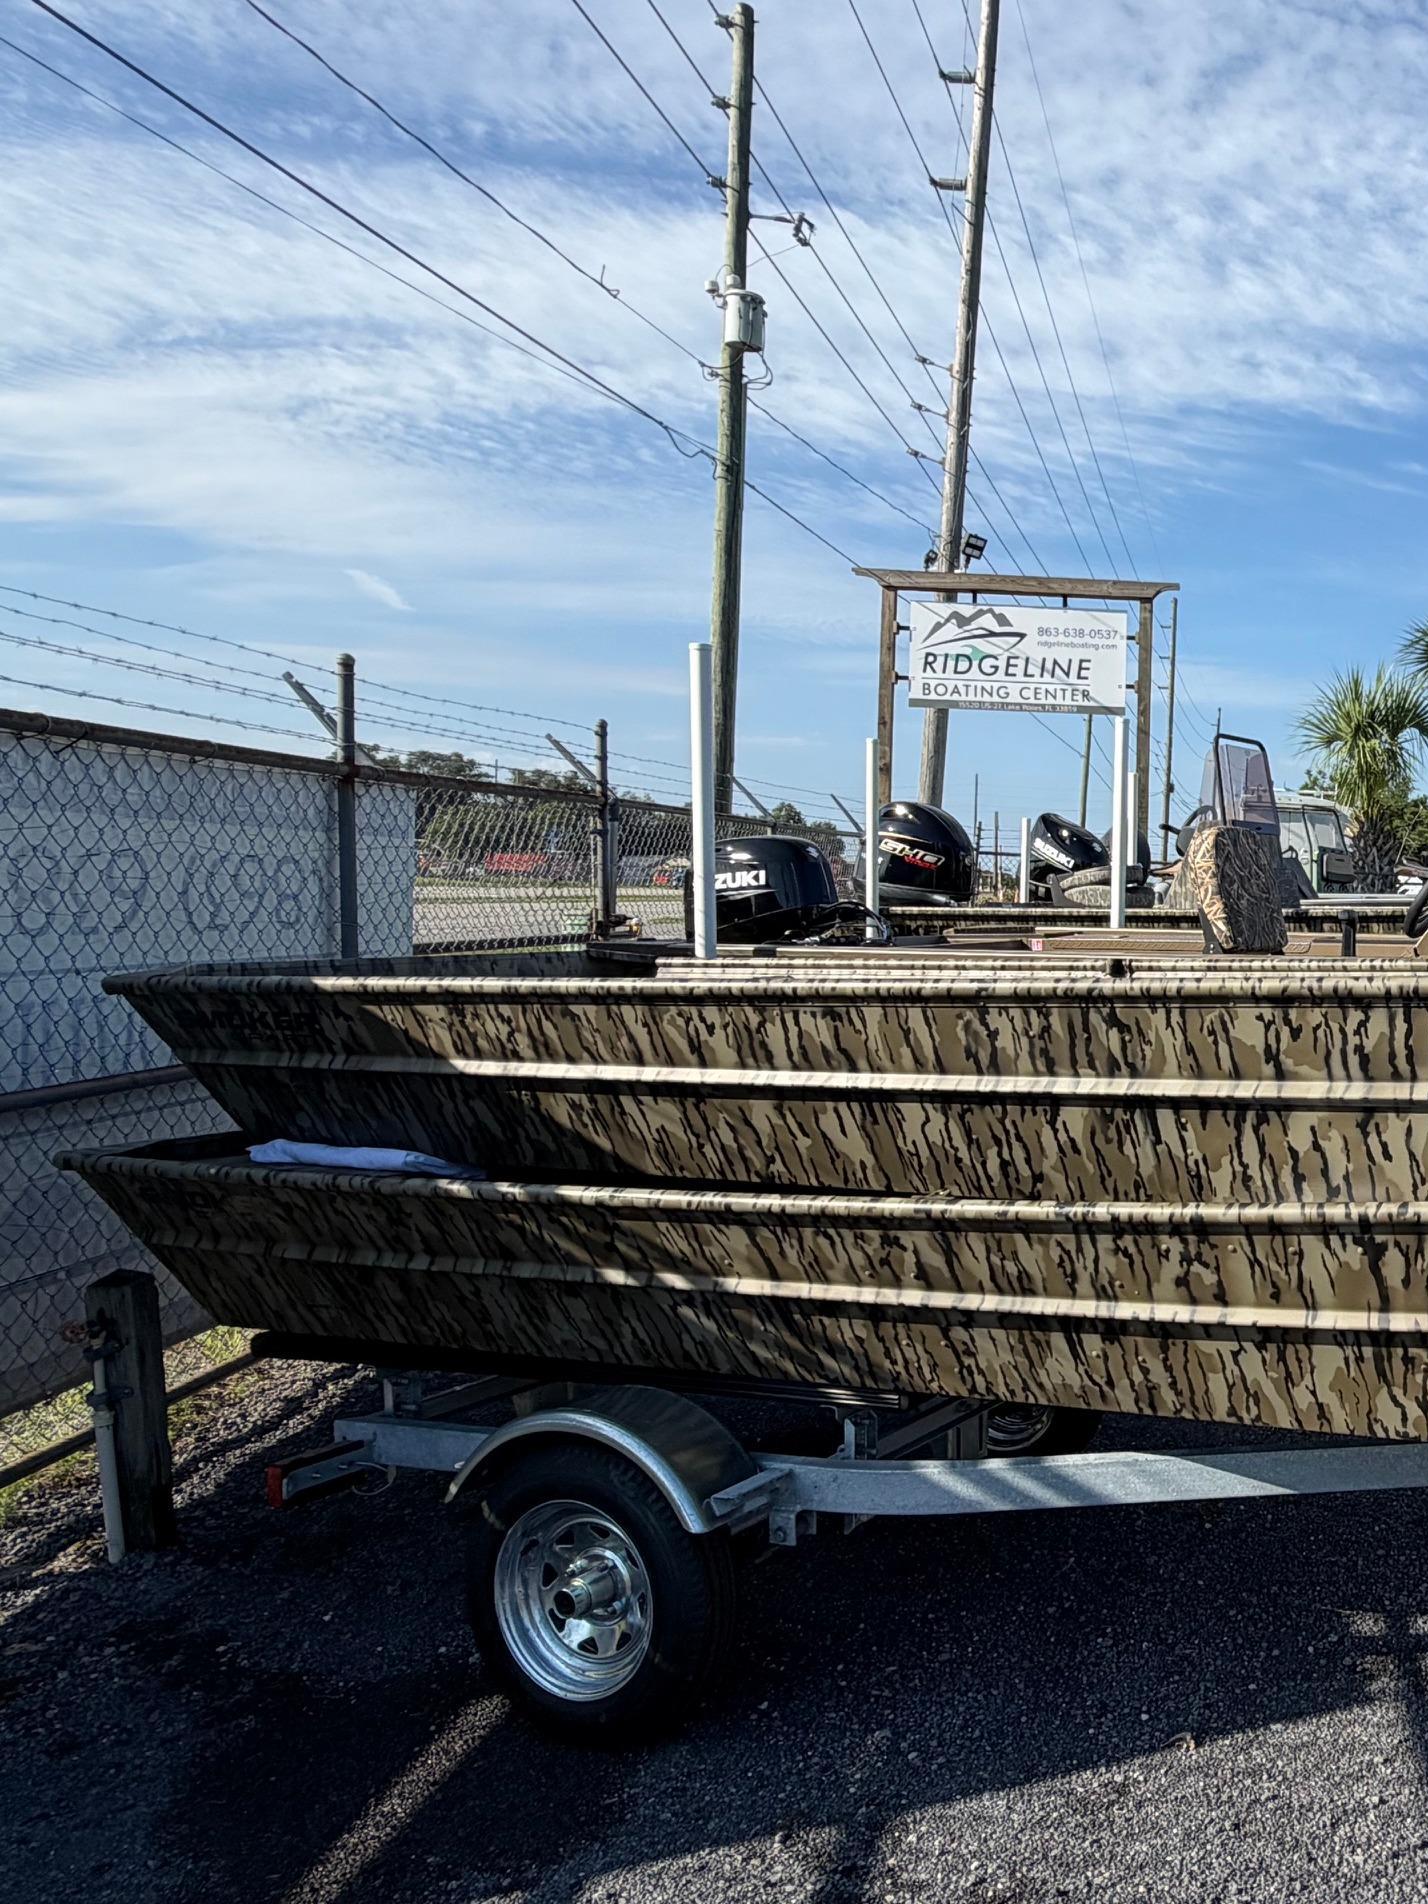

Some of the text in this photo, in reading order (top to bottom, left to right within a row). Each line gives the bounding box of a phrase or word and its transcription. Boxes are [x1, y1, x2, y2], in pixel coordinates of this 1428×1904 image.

[1037, 626, 1119, 640] 863-638-0537
[922, 652, 1091, 680] RIDGELINE
[922, 682, 1091, 703] BOATING CENTER
[1033, 837, 1075, 868] SUZUKI
[714, 870, 766, 890] ZUKI
